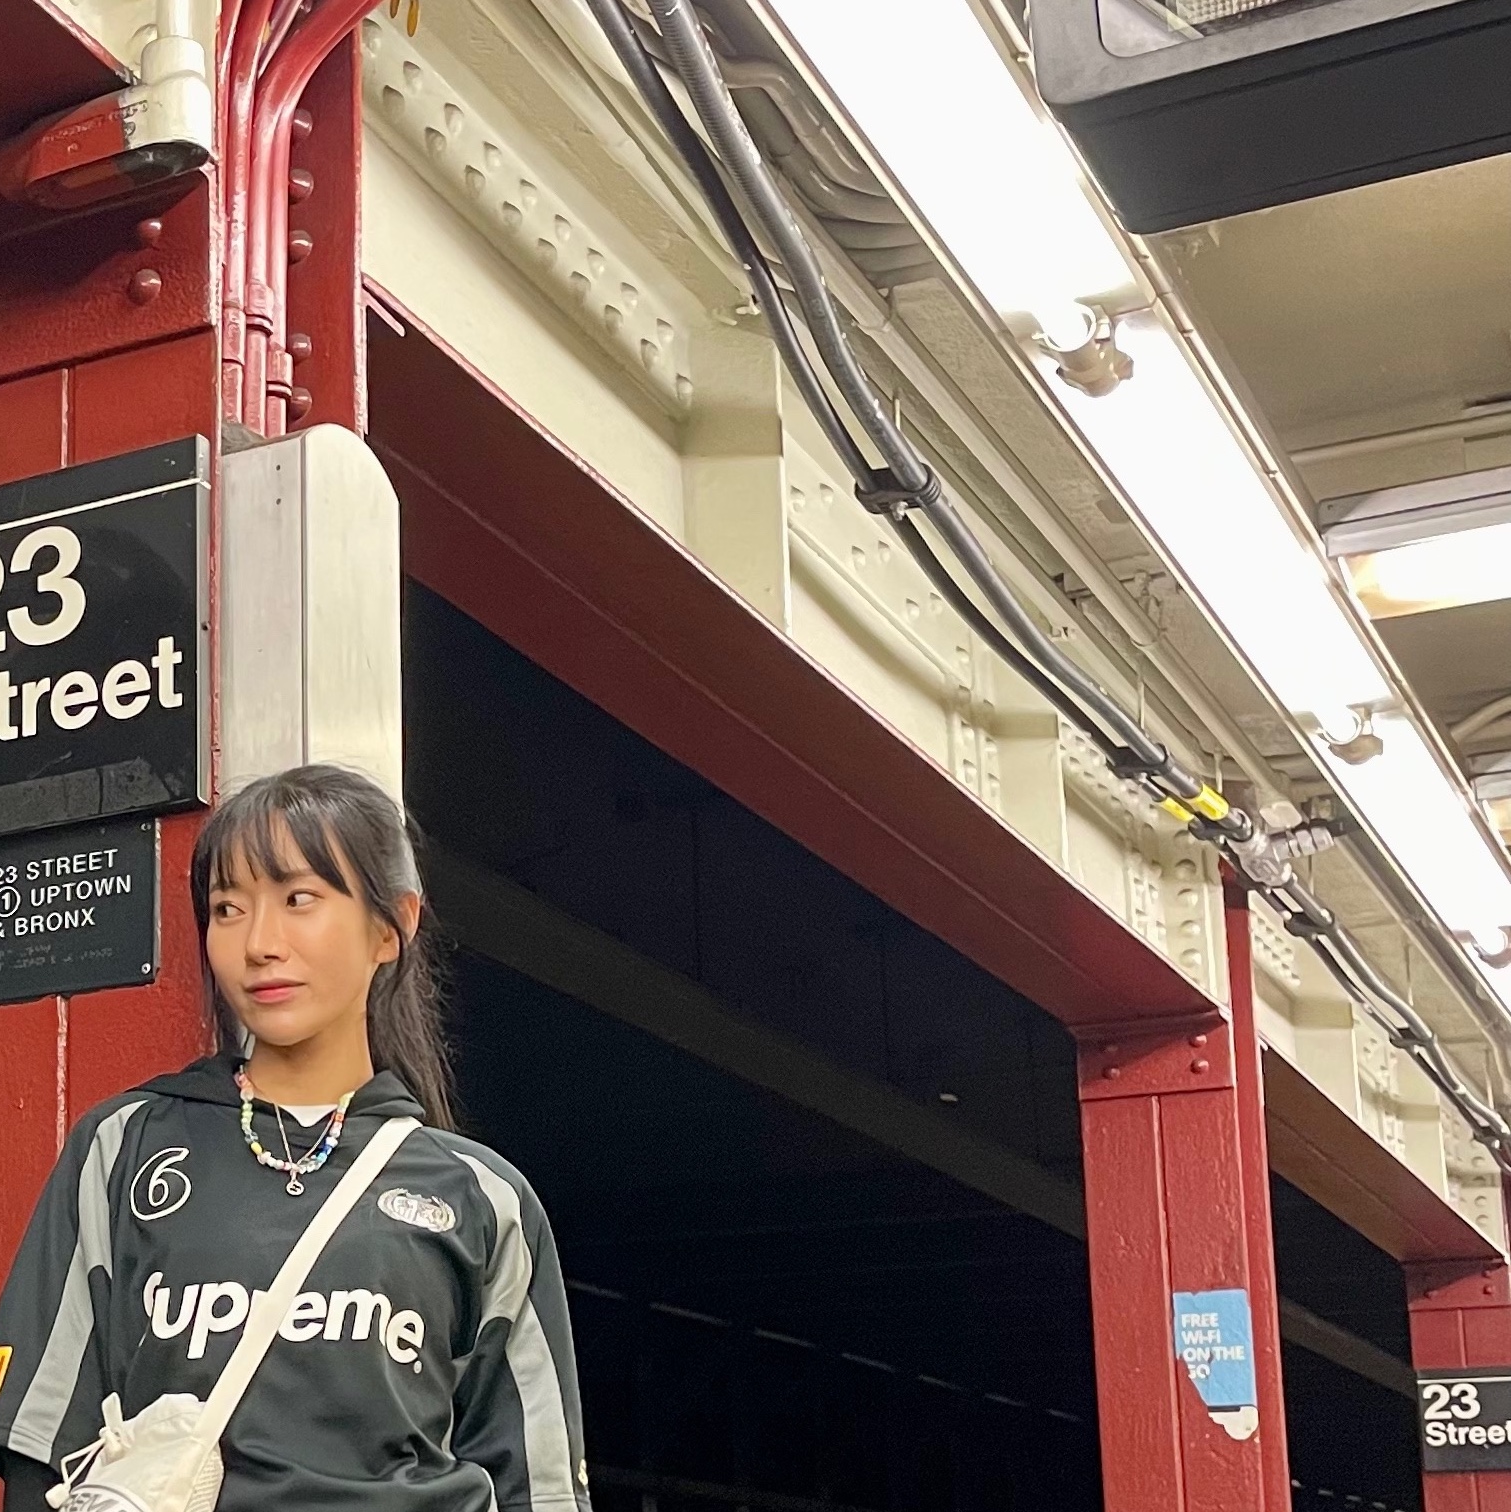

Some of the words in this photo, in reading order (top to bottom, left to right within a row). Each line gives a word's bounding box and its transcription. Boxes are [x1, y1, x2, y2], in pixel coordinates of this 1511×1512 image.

[26, 848, 118, 881] STREET
[30, 874, 132, 907] UPTOWN
[14, 907, 96, 937] BRONX
[130, 1147, 192, 1222] 6
[1181, 1312, 1219, 1328] FREE
[1181, 1328, 1221, 1345] WI-FI
[1183, 1347, 1210, 1362] ON
[1211, 1345, 1245, 1361] THE
[1422, 1383, 1481, 1420] 23
